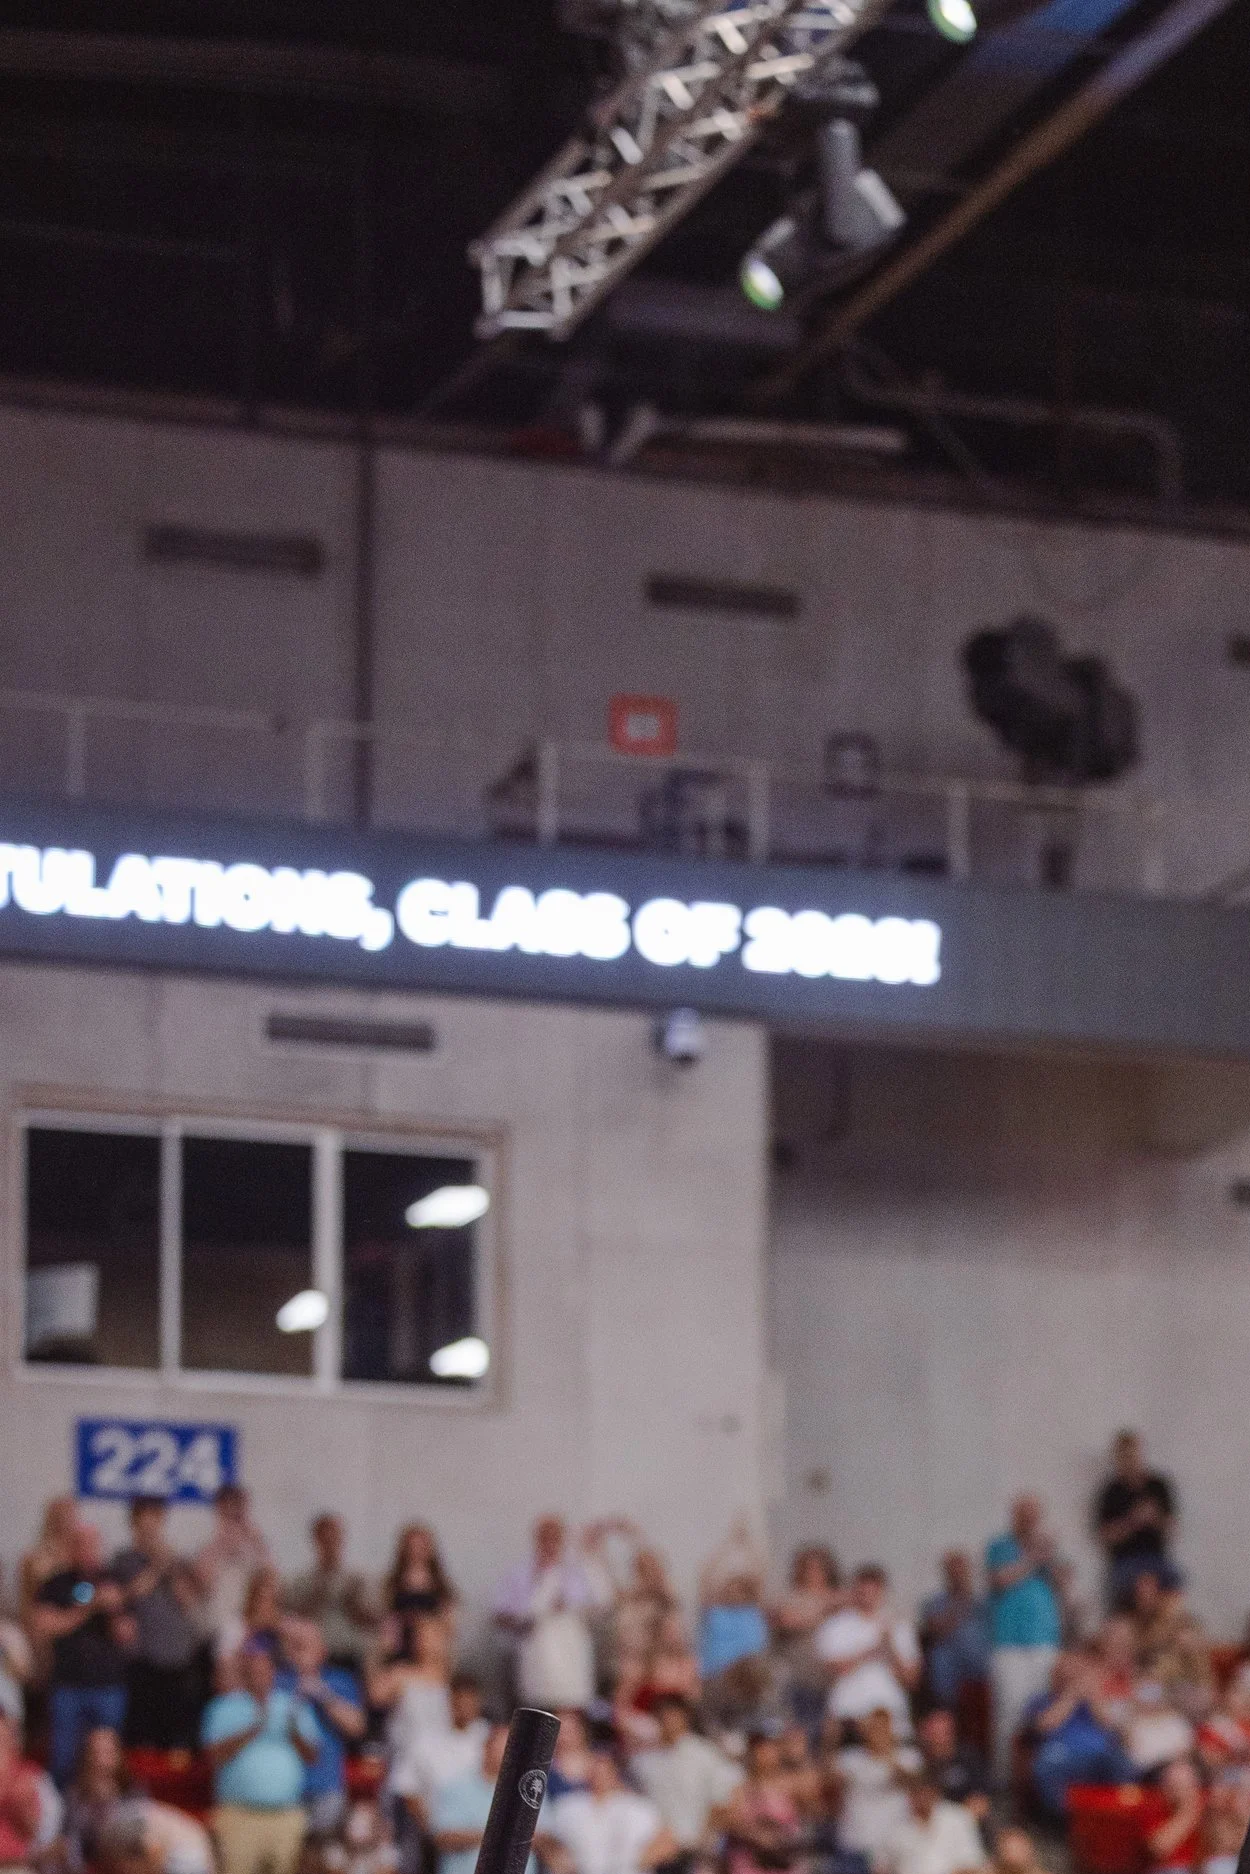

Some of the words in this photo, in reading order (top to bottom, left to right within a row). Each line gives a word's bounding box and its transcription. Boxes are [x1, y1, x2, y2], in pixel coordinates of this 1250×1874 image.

[398, 878, 631, 960] CLASS
[633, 898, 742, 967] OF
[92, 1428, 221, 1495] 224
